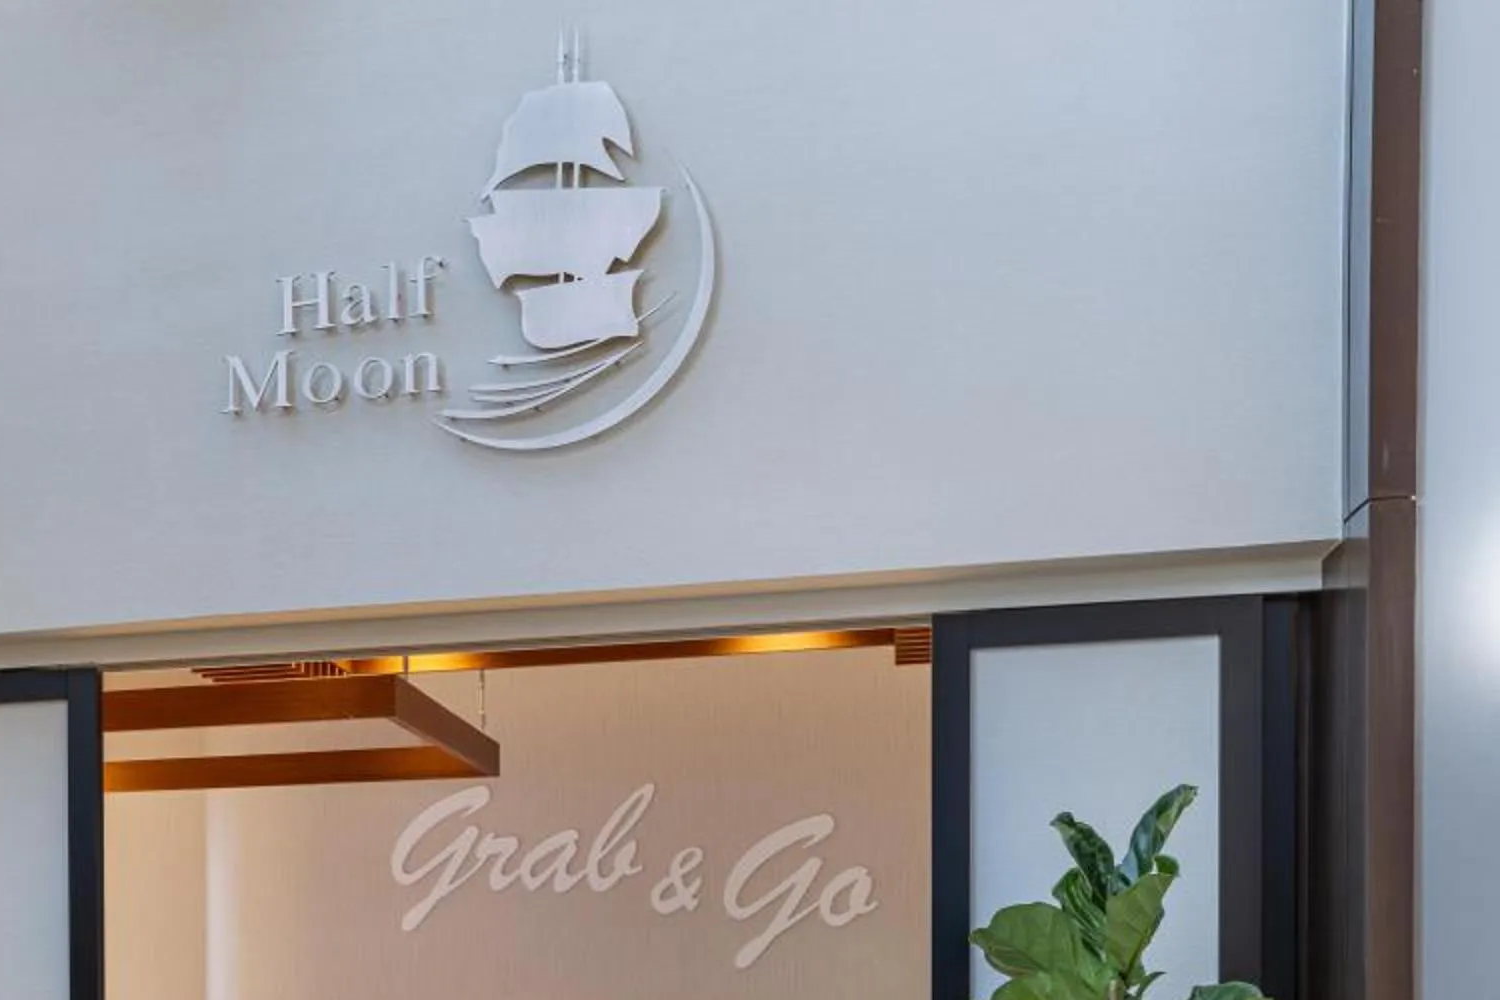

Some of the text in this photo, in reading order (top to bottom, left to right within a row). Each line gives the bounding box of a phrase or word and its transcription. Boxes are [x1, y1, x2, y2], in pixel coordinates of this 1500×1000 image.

[275, 256, 446, 335] Half
[222, 351, 442, 415] Moon
[391, 783, 879, 969] Grab & Go
